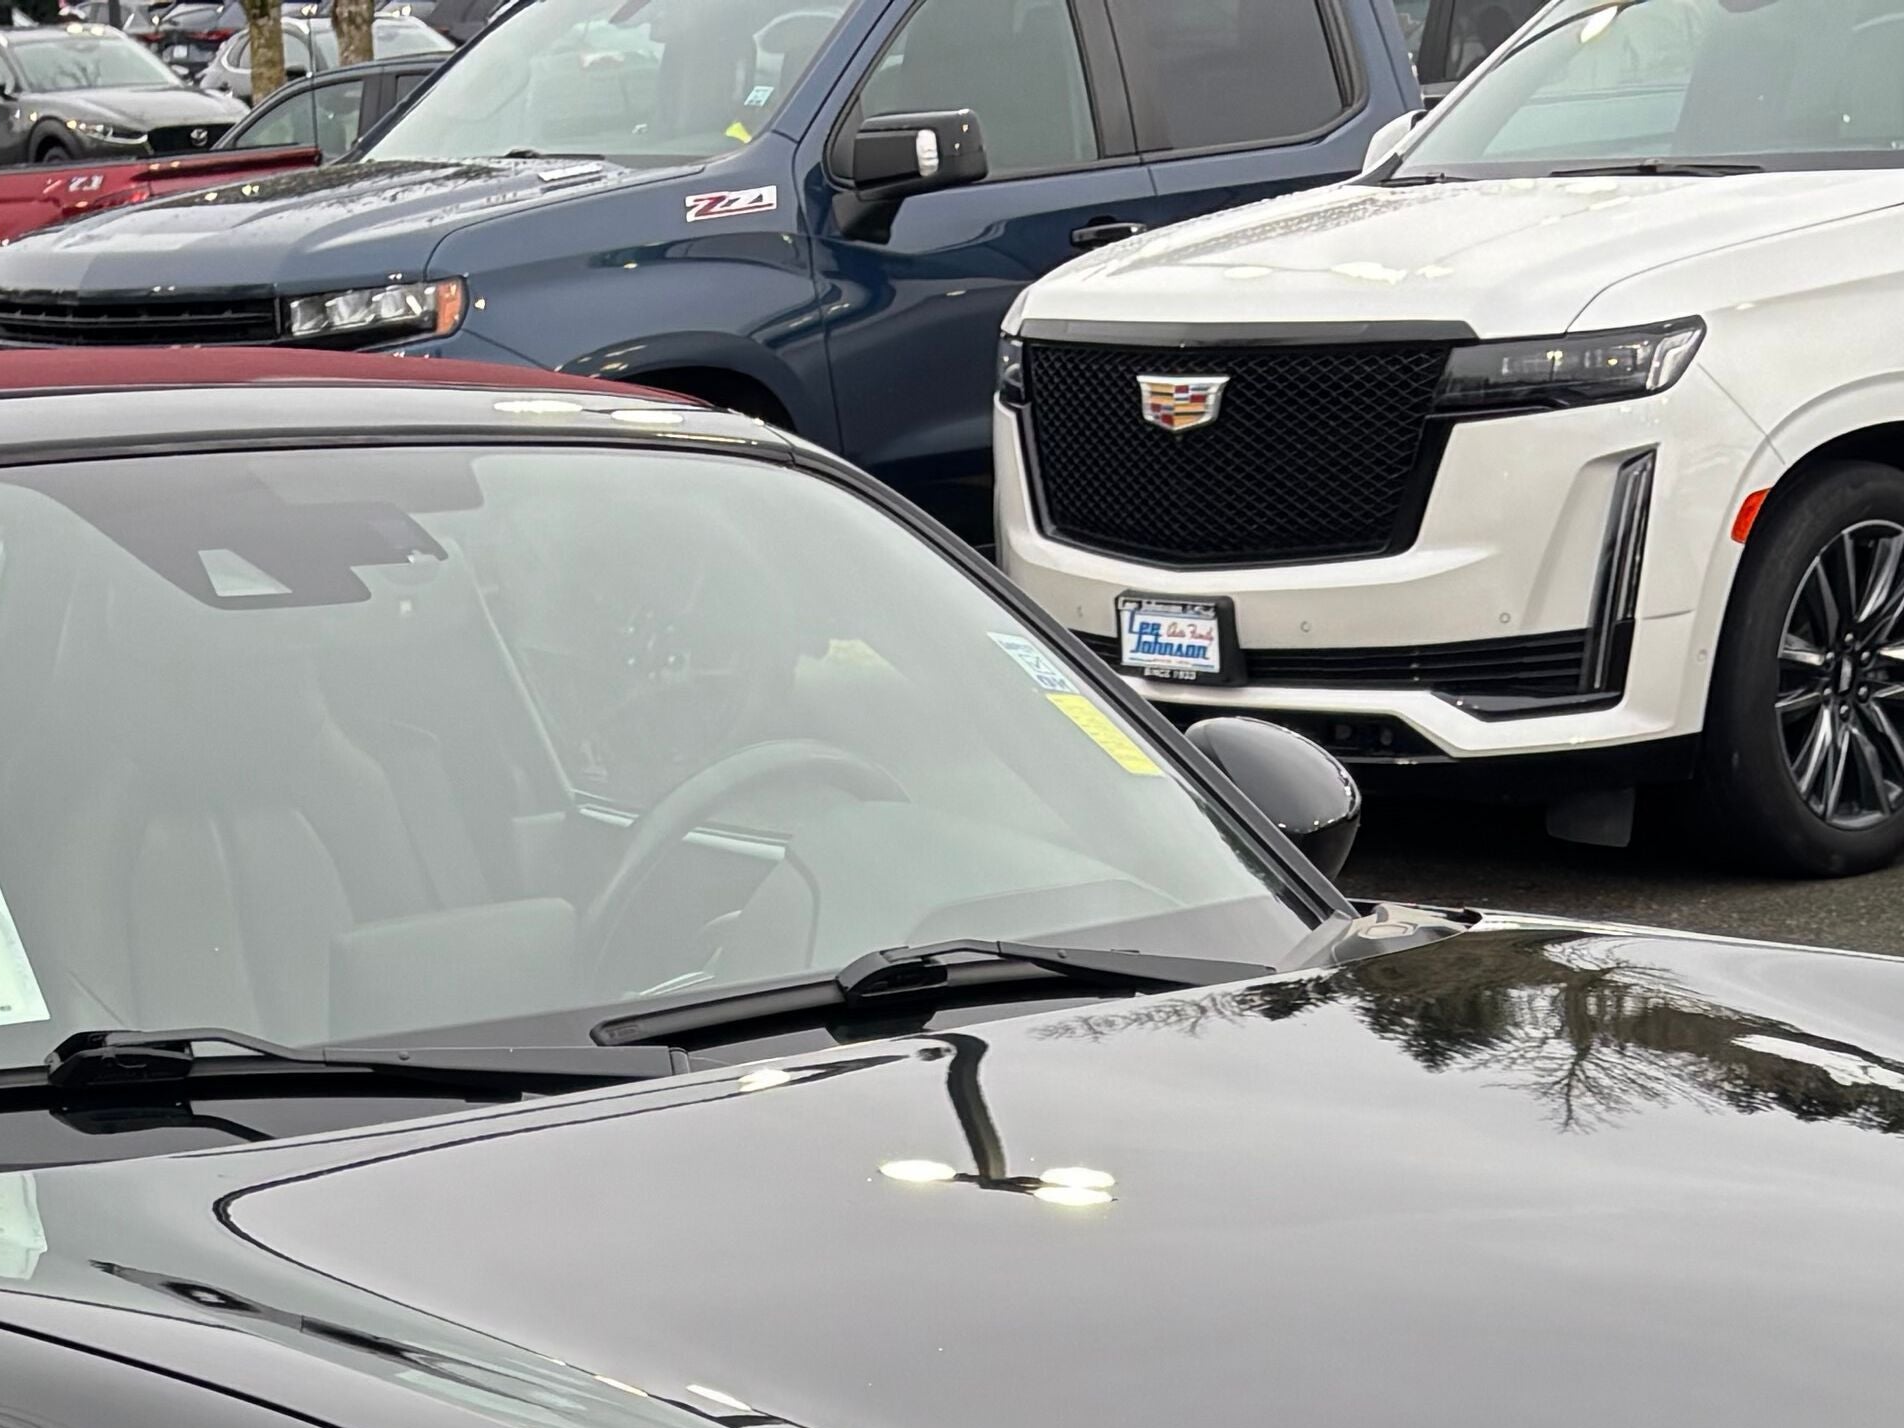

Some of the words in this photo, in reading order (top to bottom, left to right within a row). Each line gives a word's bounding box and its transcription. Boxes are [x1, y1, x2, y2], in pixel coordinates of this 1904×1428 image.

[686, 185, 777, 222] Z71
[1128, 610, 1162, 636] Lee
[1130, 635, 1210, 660] Johnson
